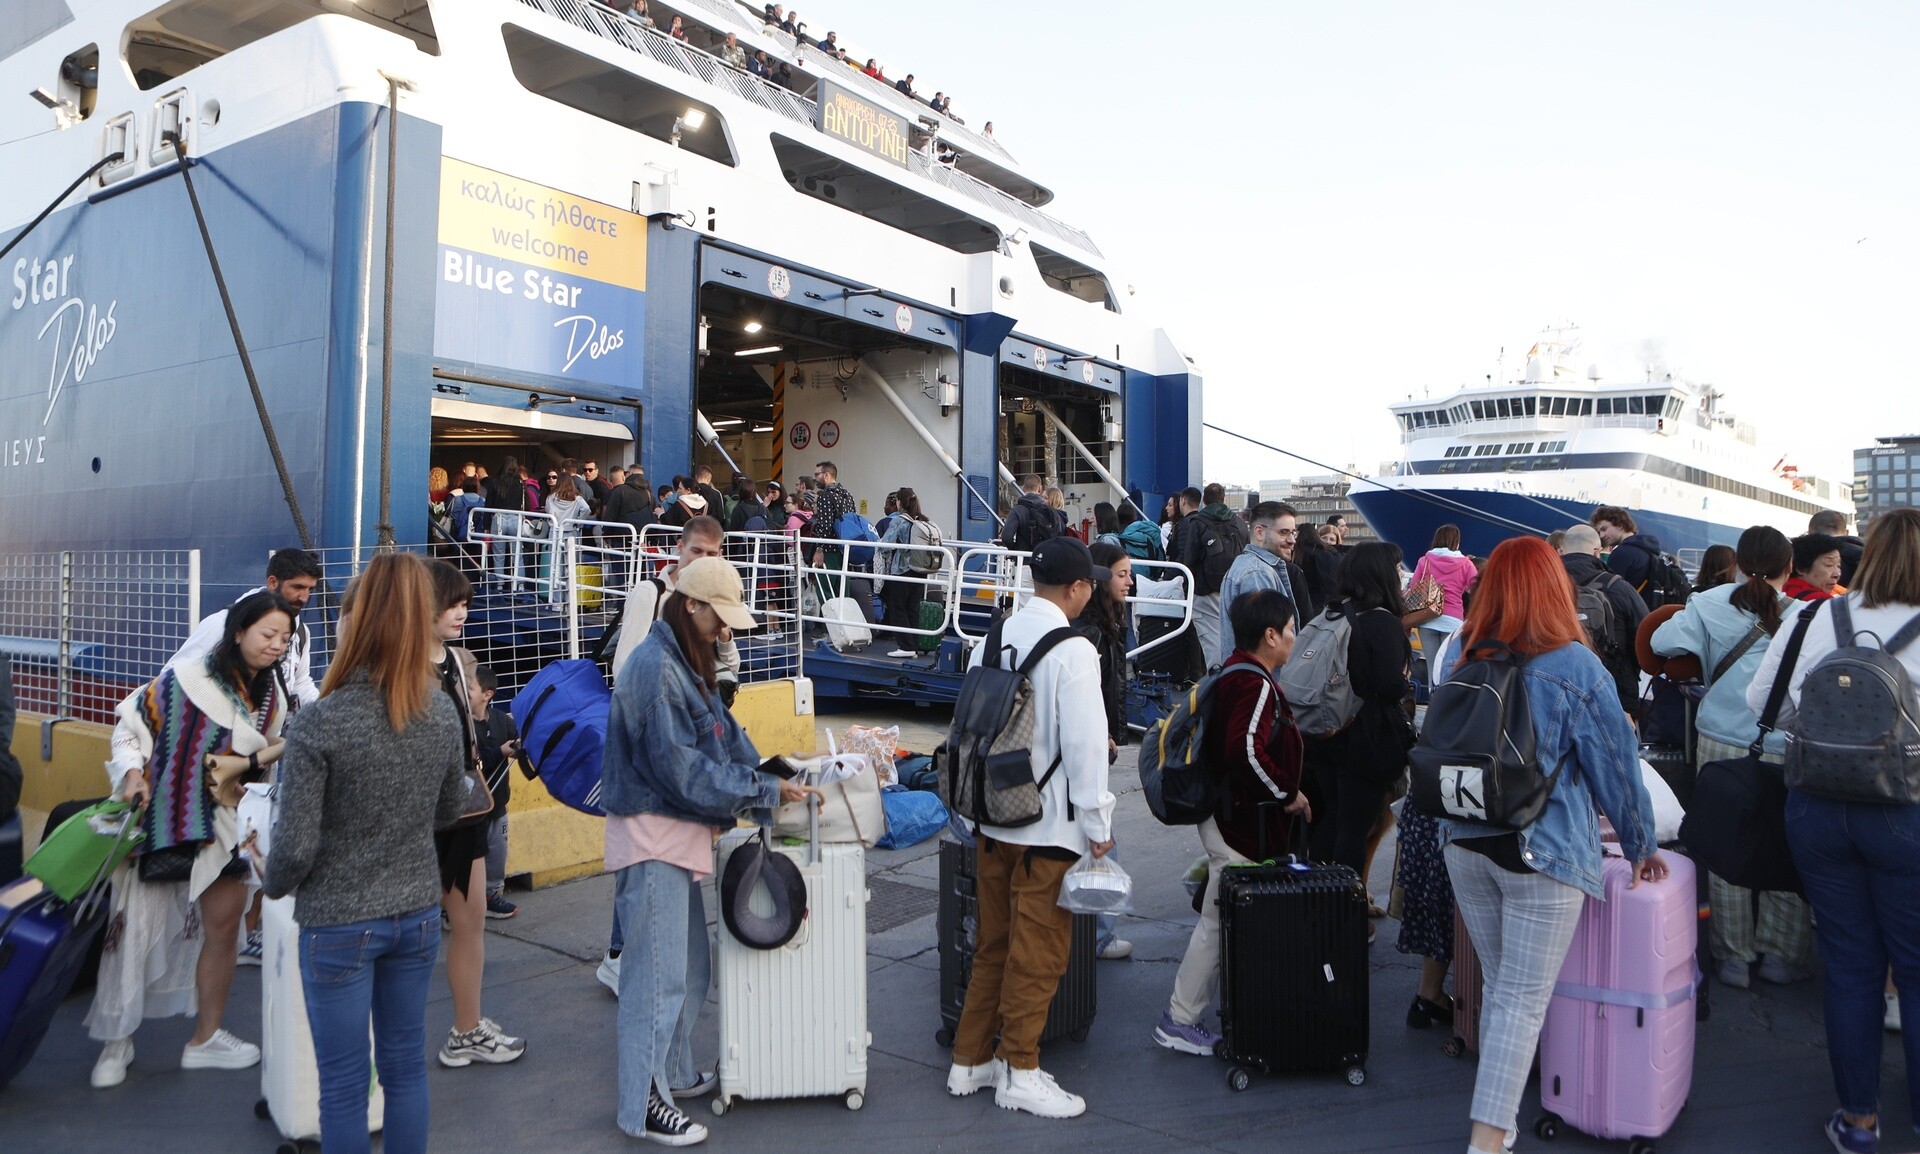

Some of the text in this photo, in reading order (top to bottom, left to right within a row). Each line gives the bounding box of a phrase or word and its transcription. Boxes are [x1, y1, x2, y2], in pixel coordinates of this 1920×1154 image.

[823, 101, 907, 165] ΑΝΤΟΡΙΝΗ
[460, 179, 618, 238] καλώς ήλθατε
[492, 227, 589, 267] welcome
[12, 253, 75, 311] Star
[444, 250, 583, 309] Blue Star
[37, 297, 117, 426] Delos
[553, 315, 624, 373] Delos
[1440, 769, 1486, 809] CK
